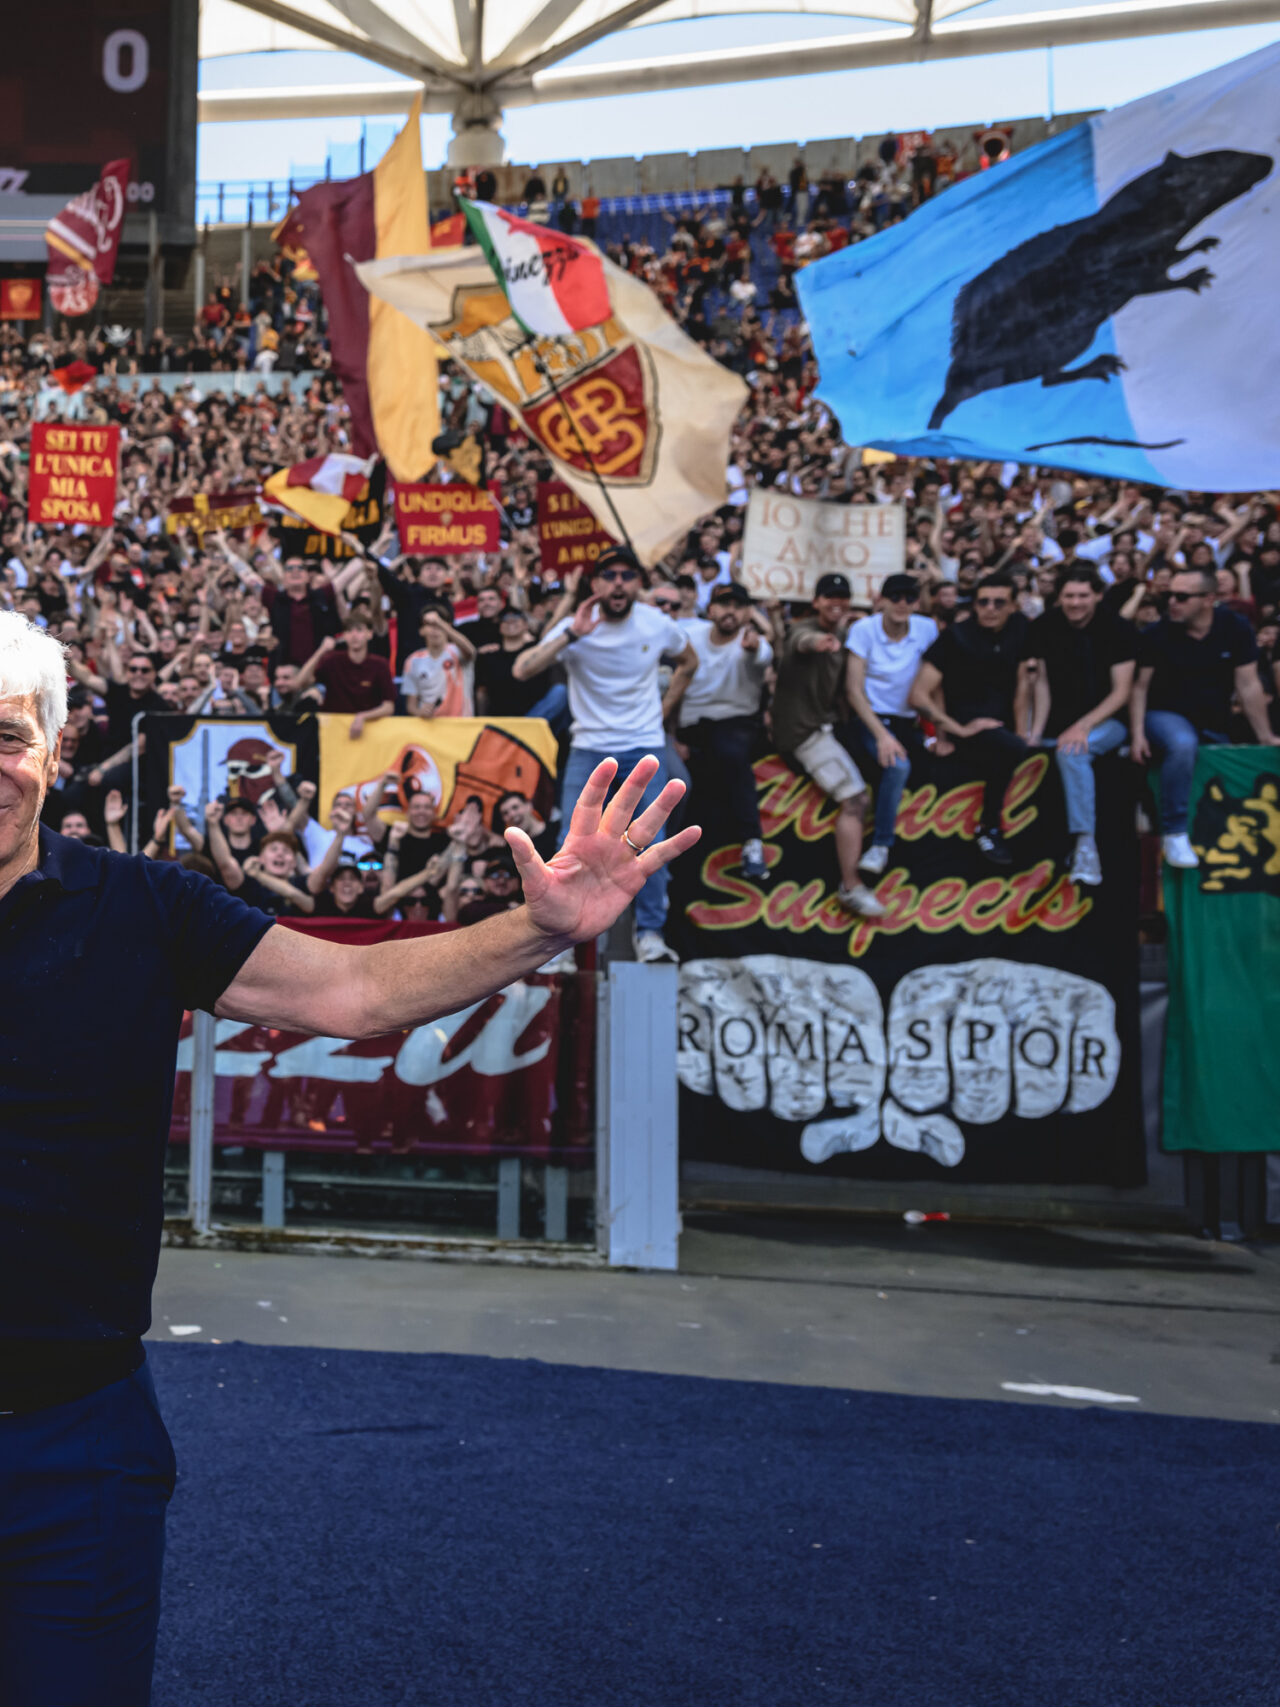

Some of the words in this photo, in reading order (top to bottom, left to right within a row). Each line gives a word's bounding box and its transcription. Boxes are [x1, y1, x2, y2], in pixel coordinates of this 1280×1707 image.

[102, 29, 149, 93] 0
[45, 429, 77, 452] SEI
[81, 430, 109, 453] TU
[34, 453, 114, 477] L'UNICA
[49, 477, 88, 498] MIA
[398, 490, 496, 512] UNDIQUE
[41, 498, 101, 522] SPOSA
[761, 499, 801, 532] IO
[813, 507, 894, 538] CHE
[407, 523, 487, 546] FIRMUS
[776, 536, 871, 568] AMO
[751, 753, 1050, 843] Uual
[686, 844, 1093, 958] Suspects
[678, 1013, 873, 1065] ROMA
